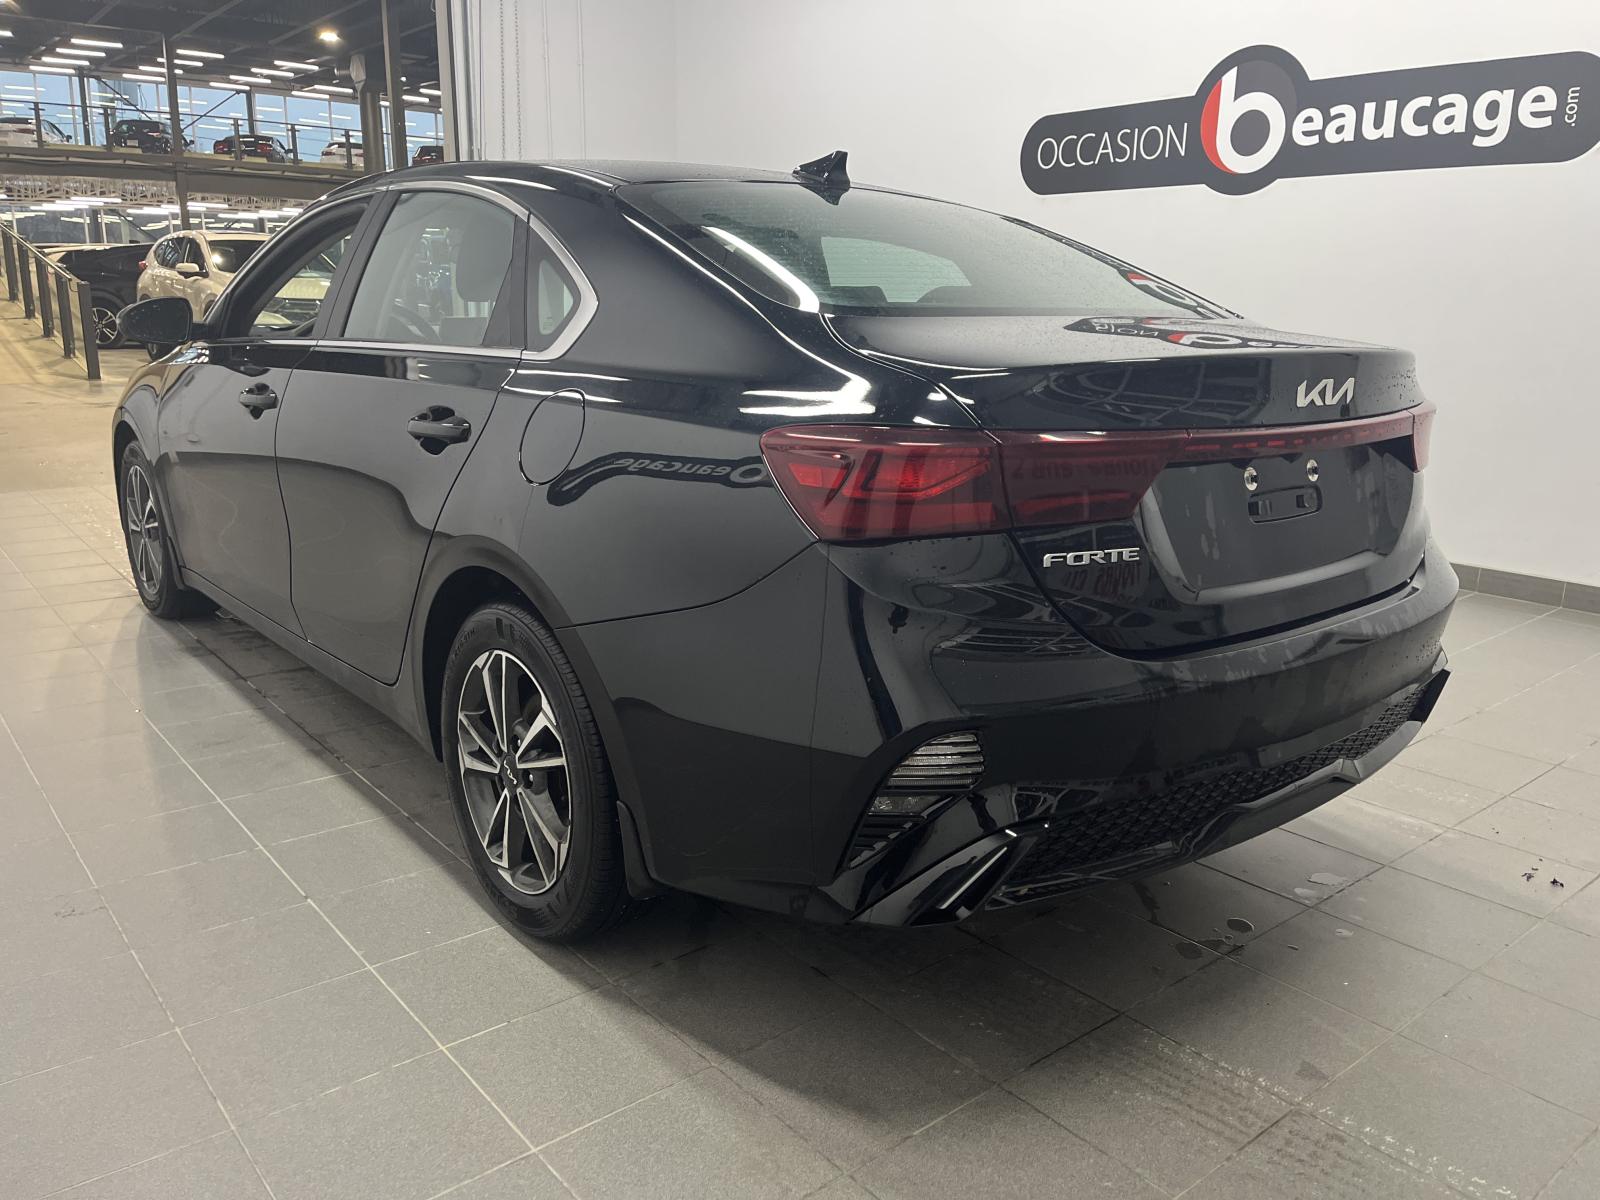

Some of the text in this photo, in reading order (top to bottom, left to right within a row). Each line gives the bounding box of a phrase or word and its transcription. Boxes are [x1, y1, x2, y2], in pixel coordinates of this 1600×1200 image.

[1037, 65, 1558, 175] OCCASION beaucage
[1564, 86, 1581, 127] .com
[1296, 377, 1355, 408] KIA
[1043, 547, 1140, 568] FORTE
